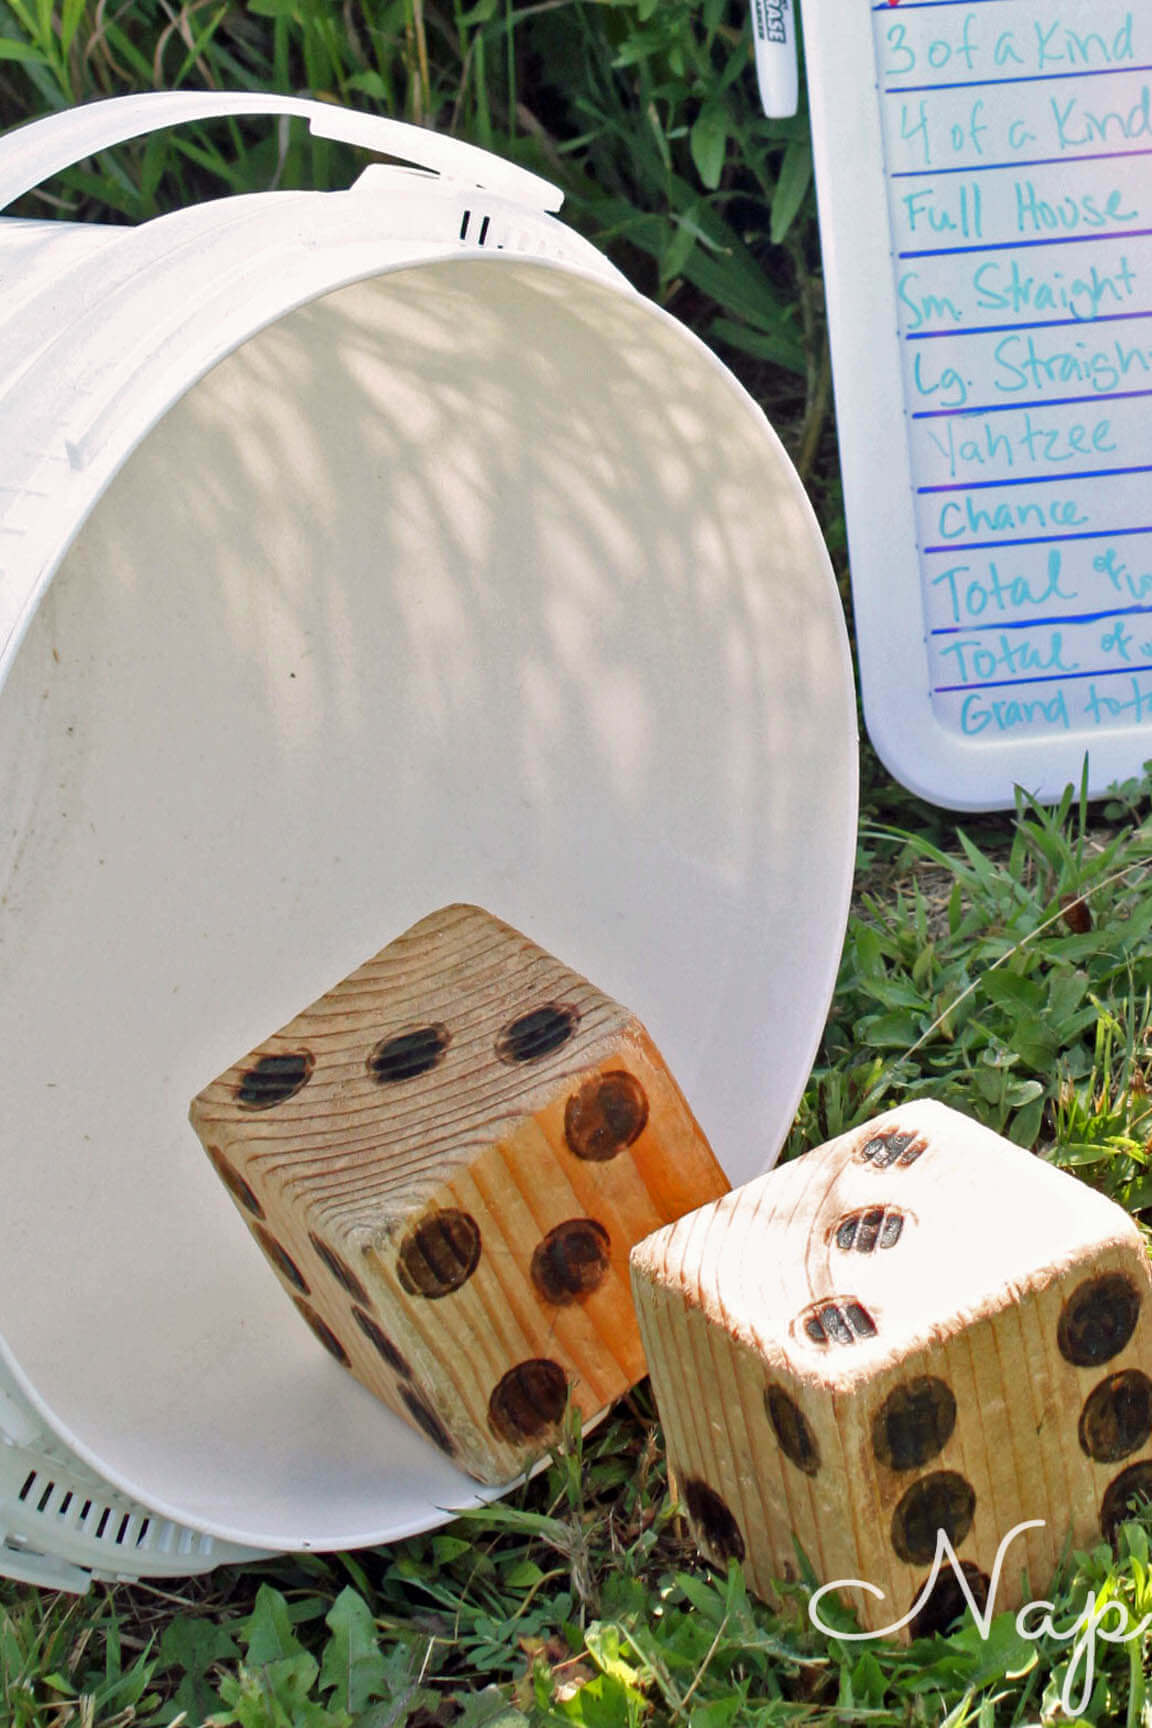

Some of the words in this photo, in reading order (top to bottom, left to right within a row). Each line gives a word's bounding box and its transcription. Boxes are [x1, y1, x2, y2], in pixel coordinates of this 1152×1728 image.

[885, 23, 915, 75] 3
[900, 99, 931, 164] 4
[950, 98, 987, 155] of
[902, 182, 982, 238] Full
[1015, 181, 1139, 232] House
[973, 256, 1136, 322] Straight
[928, 414, 1117, 477] Yahtzee
[938, 496, 1089, 539] Chance
[931, 548, 1079, 623] Total
[940, 632, 1080, 683] Total
[960, 690, 1070, 733] Grand
